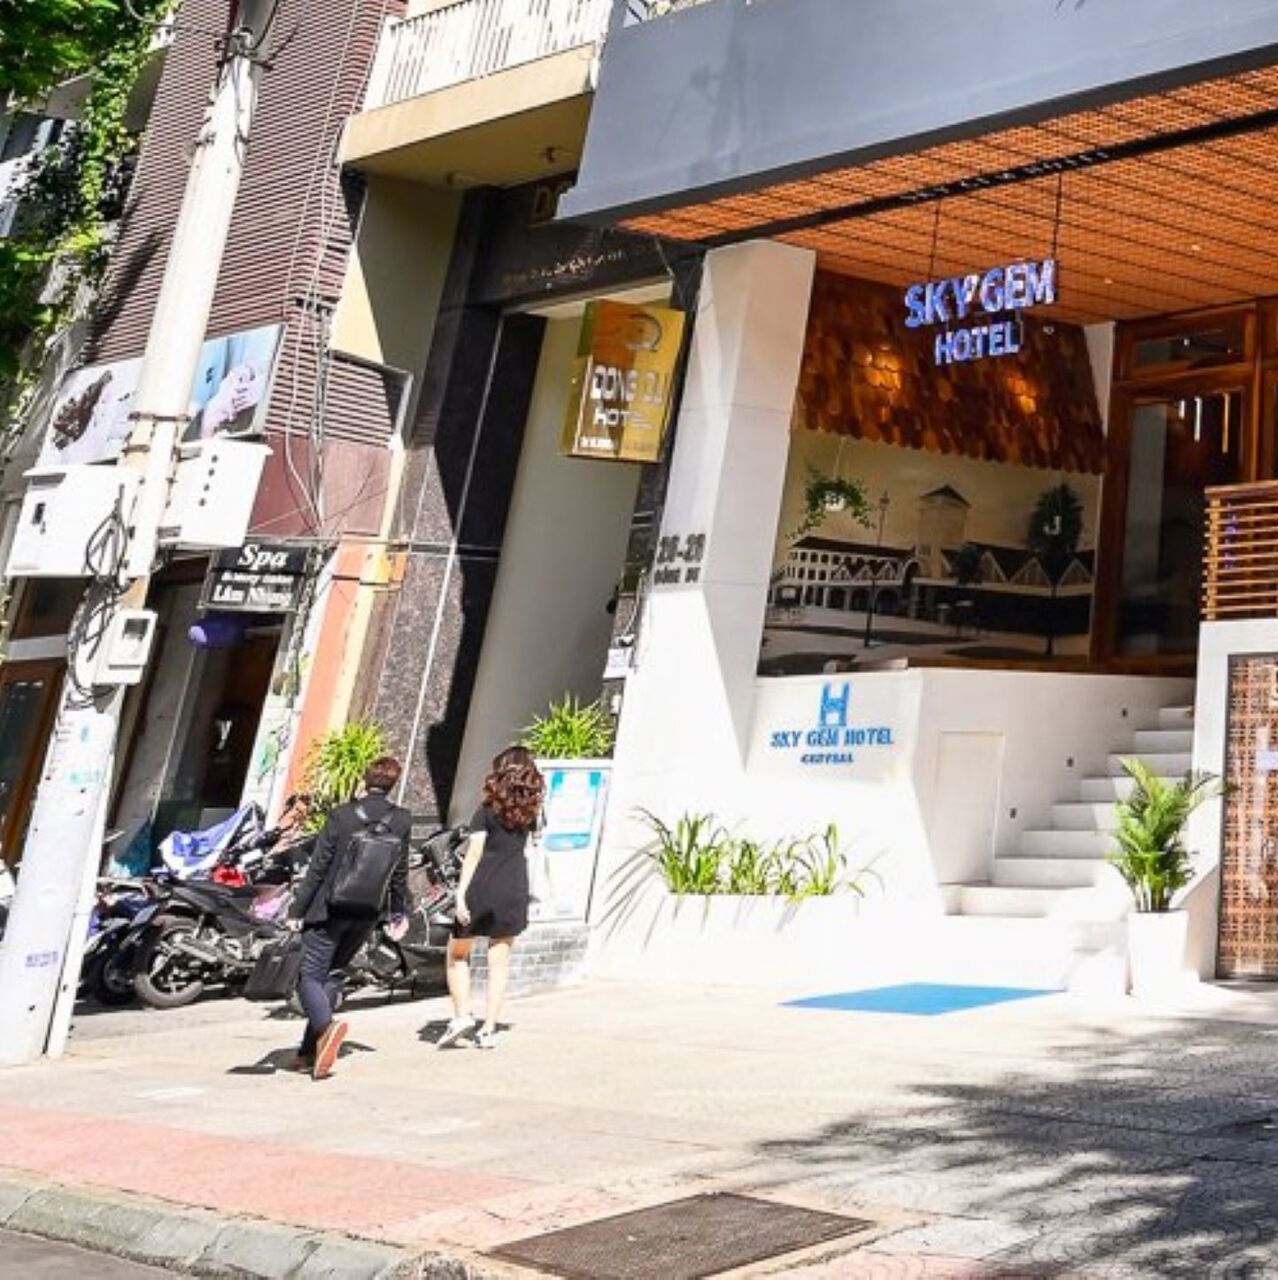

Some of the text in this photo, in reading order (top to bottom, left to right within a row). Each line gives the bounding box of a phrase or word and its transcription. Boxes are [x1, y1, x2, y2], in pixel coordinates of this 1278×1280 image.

[904, 259, 1055, 328] SKY GEM
[935, 320, 1019, 366] HOTEL
[237, 543, 289, 571] Spa
[770, 727, 894, 748] SKY GEM HOTEL
